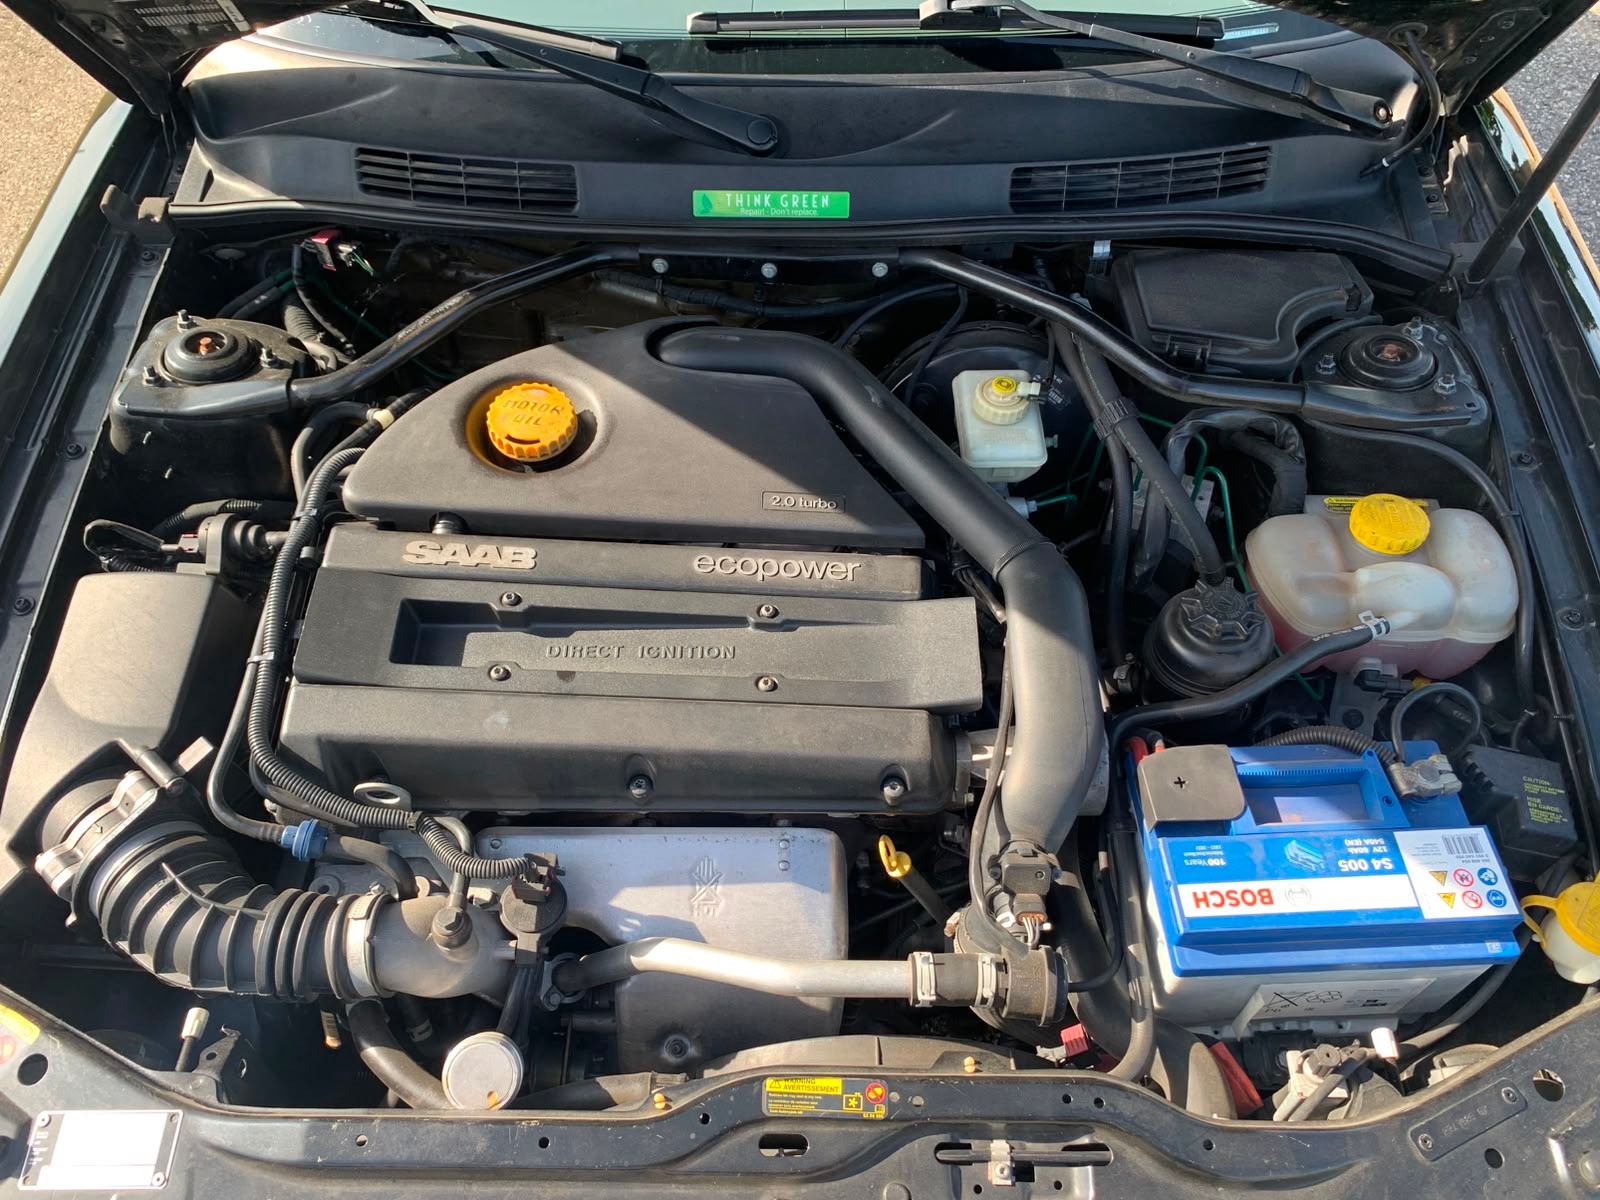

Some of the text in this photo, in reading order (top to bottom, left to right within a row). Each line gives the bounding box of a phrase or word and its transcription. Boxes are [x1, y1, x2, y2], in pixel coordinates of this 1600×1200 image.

[726, 193, 830, 208] THINK GREEN
[770, 207, 790, 216] Don't
[503, 399, 564, 415] MOTOR
[512, 414, 543, 426] OIL
[771, 495, 838, 509] 2.0 turbo
[402, 540, 862, 582] SAAB ecopower
[545, 644, 736, 659] DIRECT IGNITION
[1344, 838, 1385, 847] 540A (EN)
[1373, 845, 1388, 854] 12V
[1337, 857, 1395, 872] S4 005
[1191, 887, 1275, 909] BOSCH
